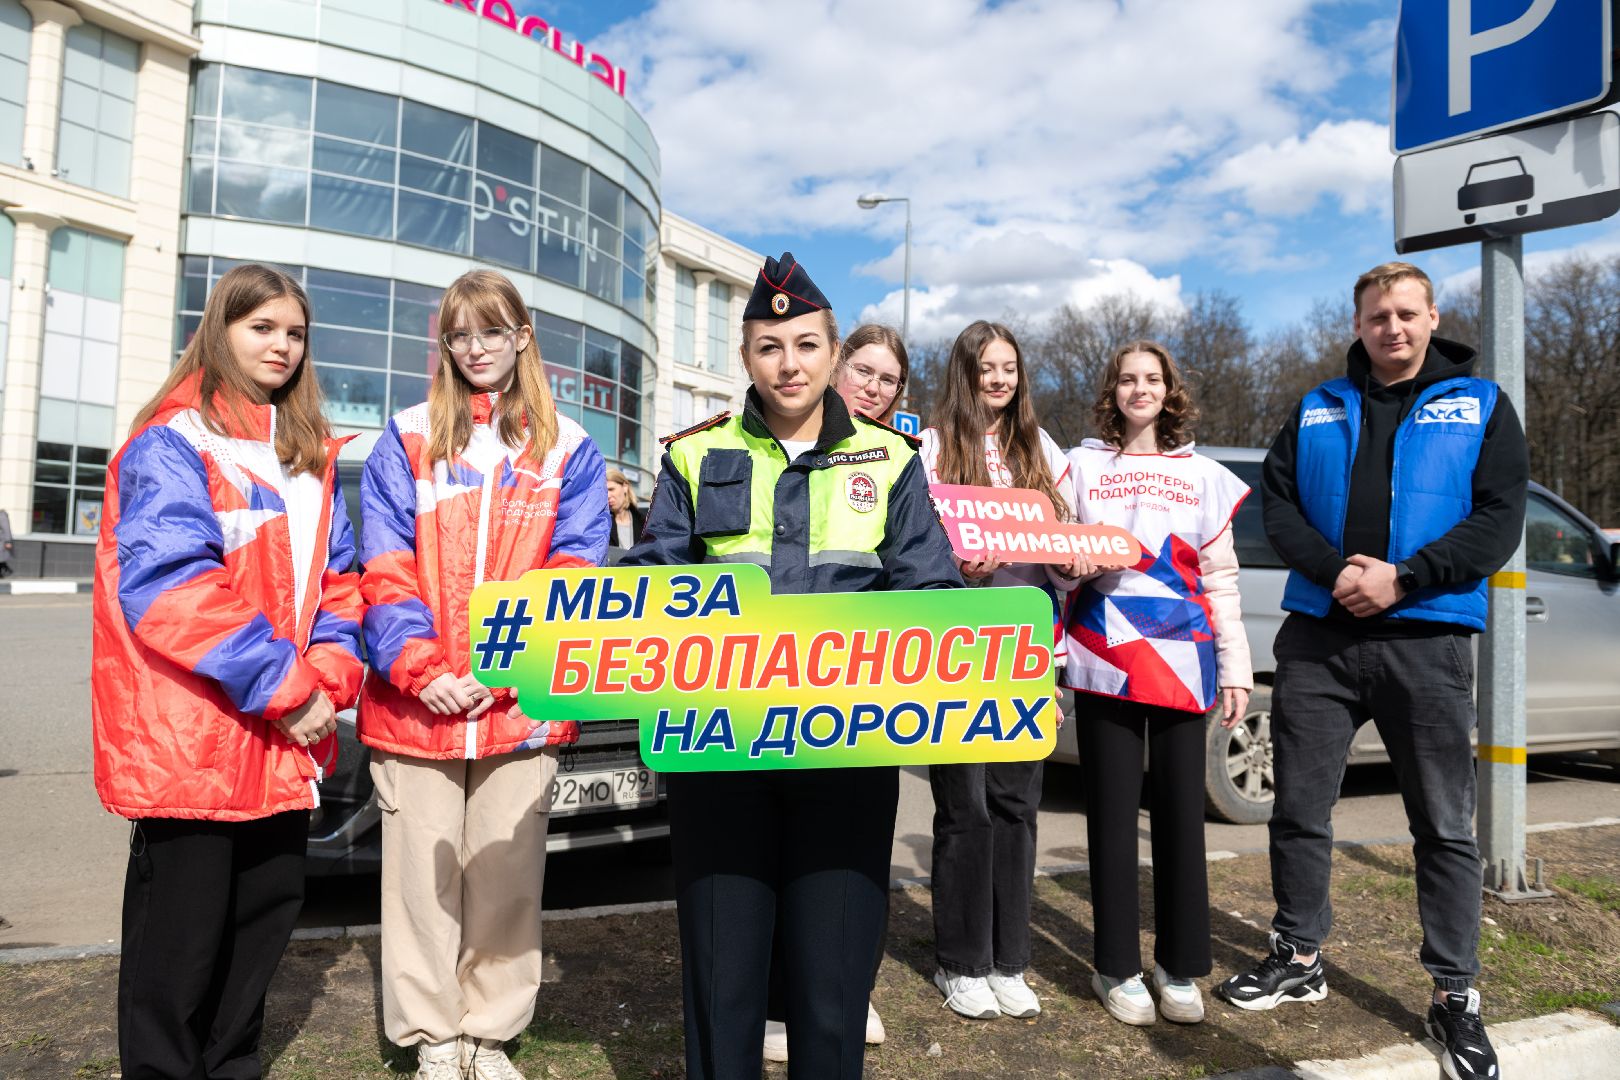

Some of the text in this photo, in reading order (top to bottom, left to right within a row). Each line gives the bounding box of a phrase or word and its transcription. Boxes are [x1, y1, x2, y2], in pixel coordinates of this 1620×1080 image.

[935, 497, 1046, 523] ключи
[957, 521, 1131, 556] Внимание
[545, 576, 649, 621] МЫ
[663, 573, 741, 618] ЗА
[550, 624, 1051, 695] БЕЗОПАСНОСТЬ
[651, 697, 1050, 758] НА ДОРОГАХ
